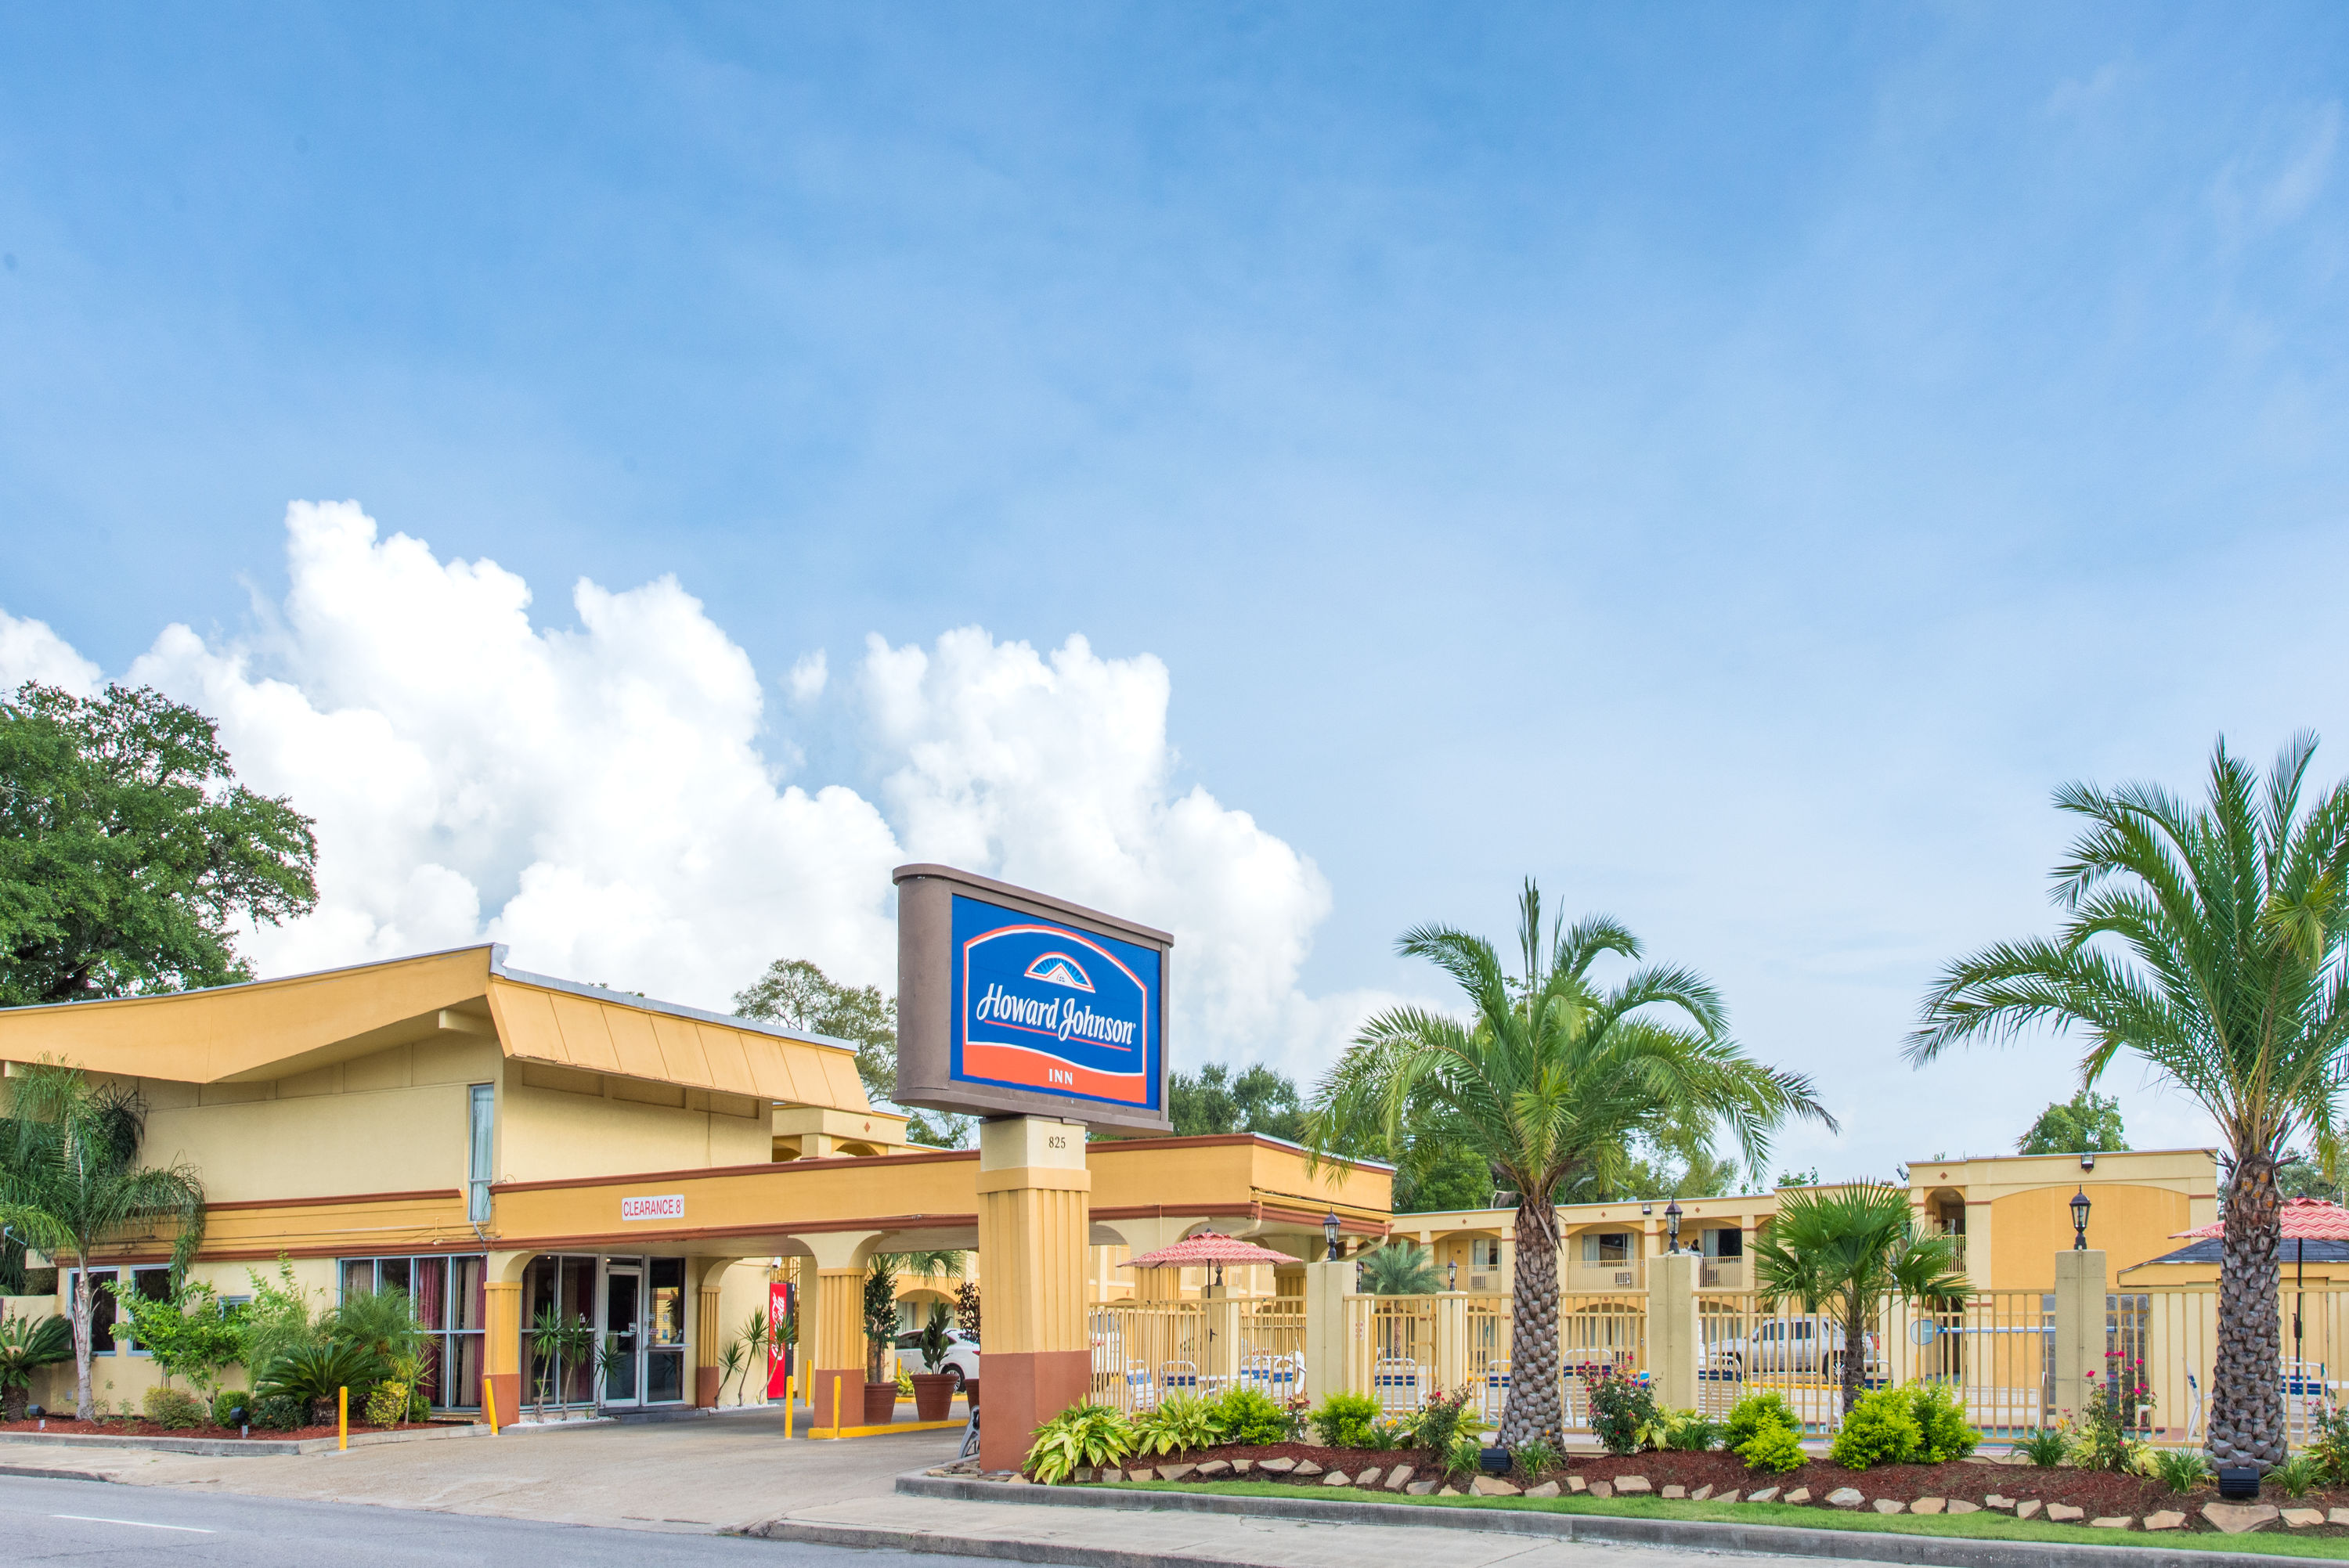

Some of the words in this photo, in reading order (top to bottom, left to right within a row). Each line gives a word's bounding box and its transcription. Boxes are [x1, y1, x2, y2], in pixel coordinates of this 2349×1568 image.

[976, 983, 1059, 1029] Howard
[1058, 998, 1133, 1045] Johnson
[1048, 1069, 1073, 1086] INN
[1048, 1136, 1066, 1149] 825
[623, 1199, 674, 1217] CLEARANCE
[770, 1292, 785, 1361] CCola
